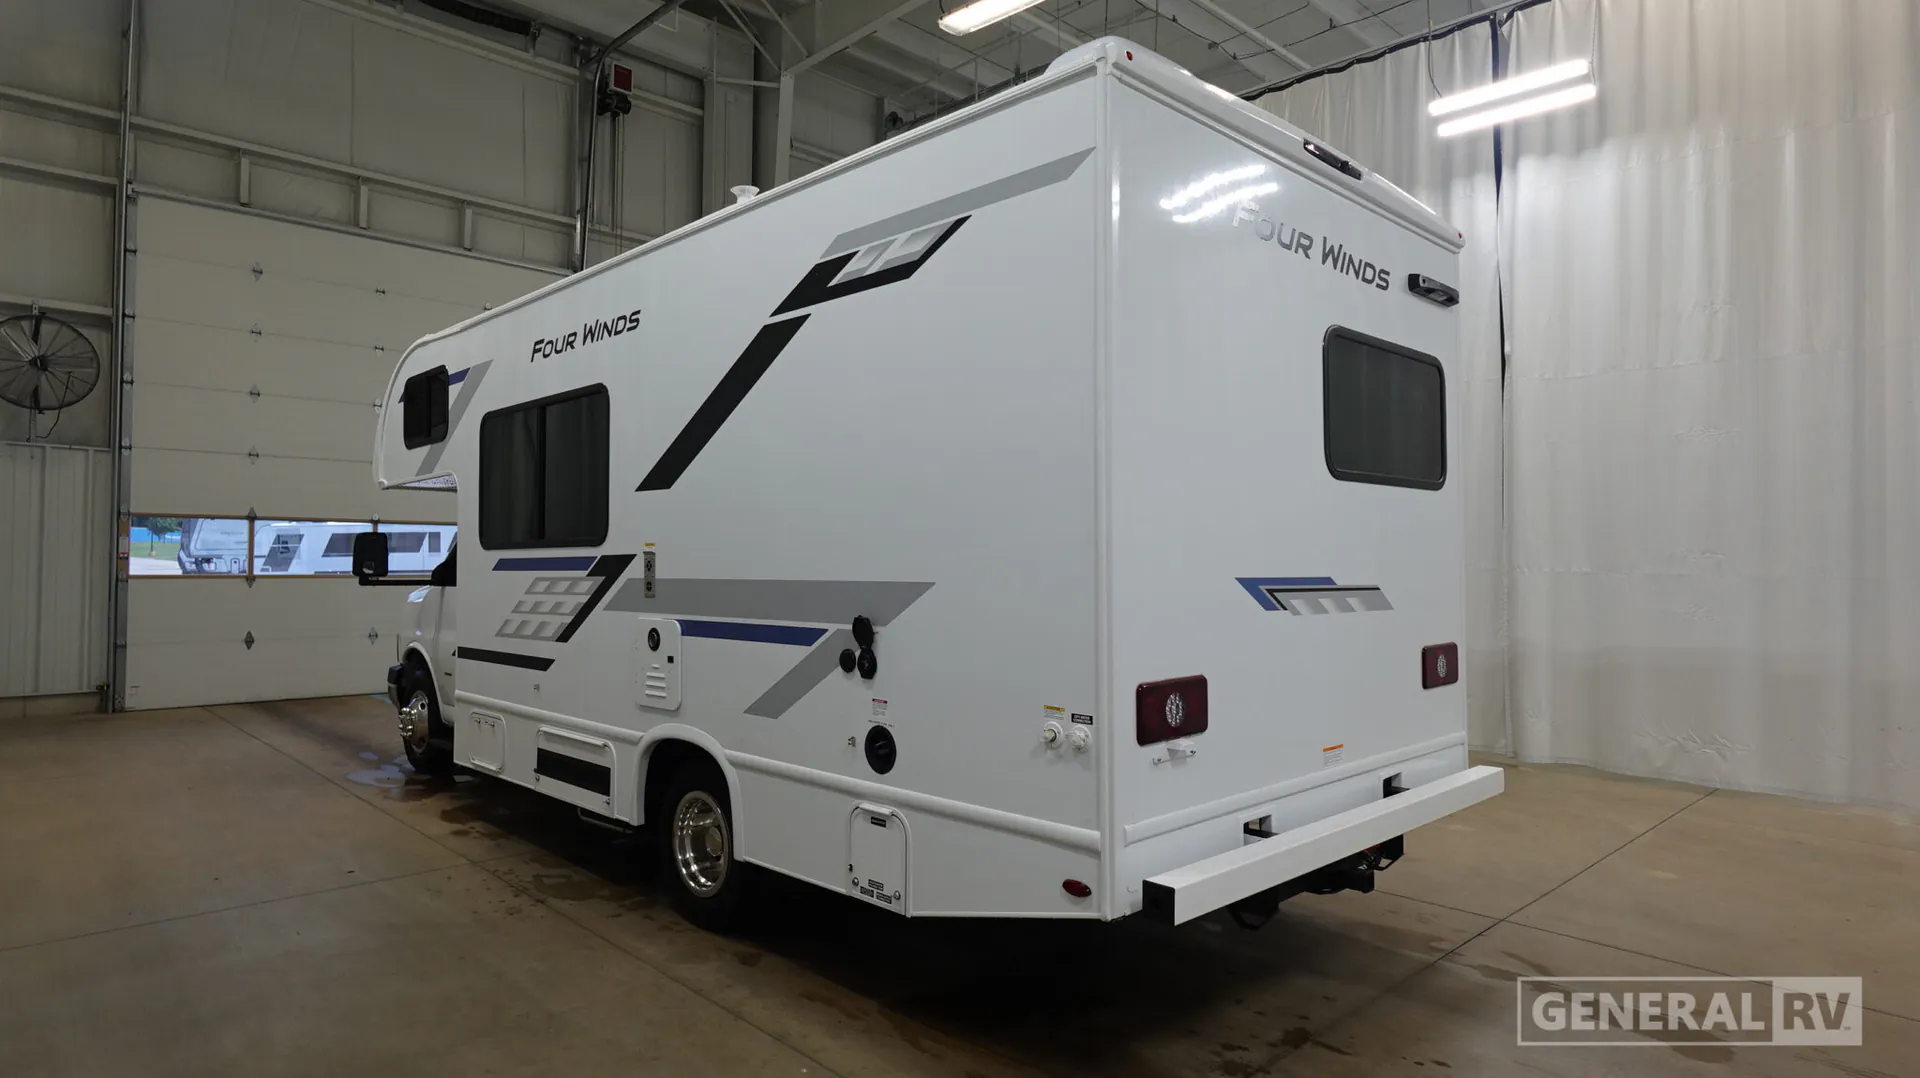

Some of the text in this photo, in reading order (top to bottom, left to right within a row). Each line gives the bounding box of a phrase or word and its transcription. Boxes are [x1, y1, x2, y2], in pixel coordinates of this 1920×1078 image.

[1232, 200, 1390, 291] FOUR WINDS
[531, 309, 641, 363] FOUR WINDS
